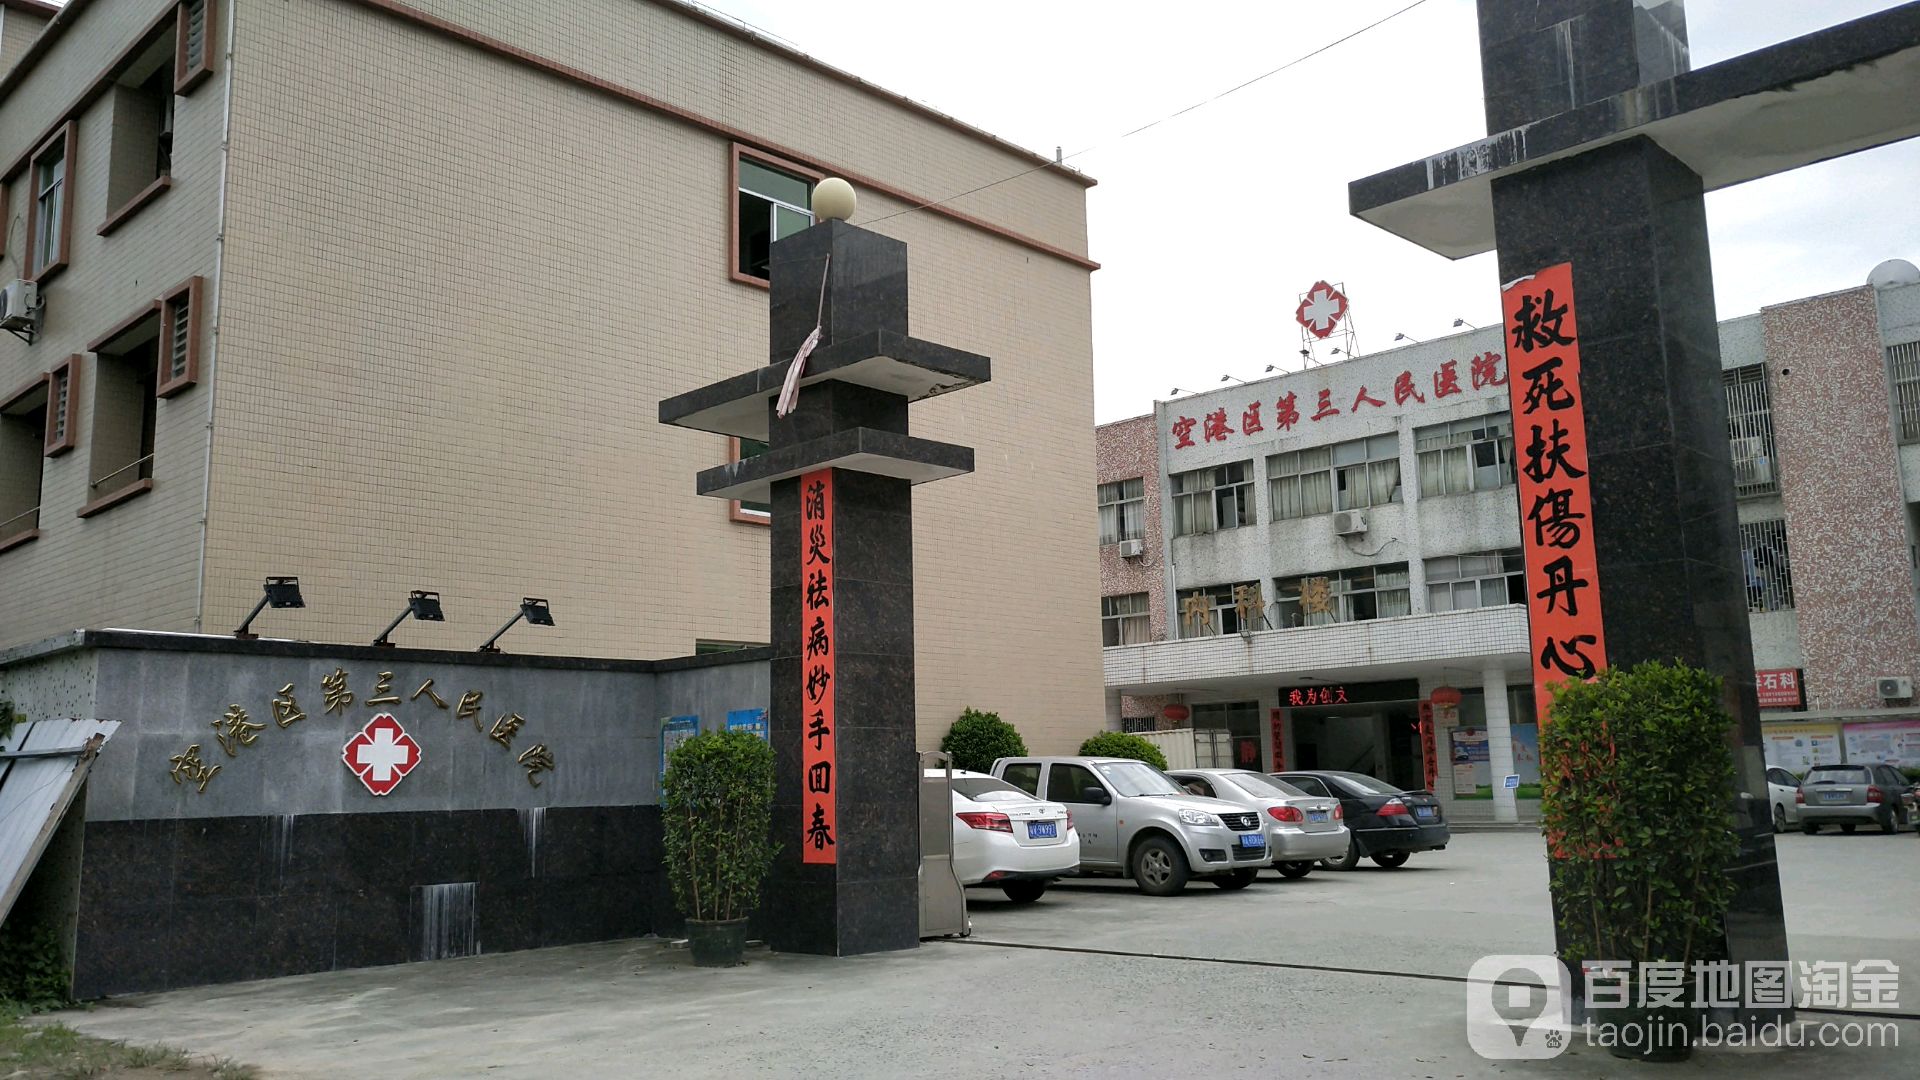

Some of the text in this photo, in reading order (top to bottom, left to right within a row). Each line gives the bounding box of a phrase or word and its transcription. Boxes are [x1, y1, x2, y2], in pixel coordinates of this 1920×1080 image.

[1171, 351, 1507, 449] 空港区第三人民医院
[1511, 288, 1597, 681] 救死扶傷丹心
[169, 666, 555, 793] 空港区第三人民医院
[1288, 687, 1349, 706] 我为创文
